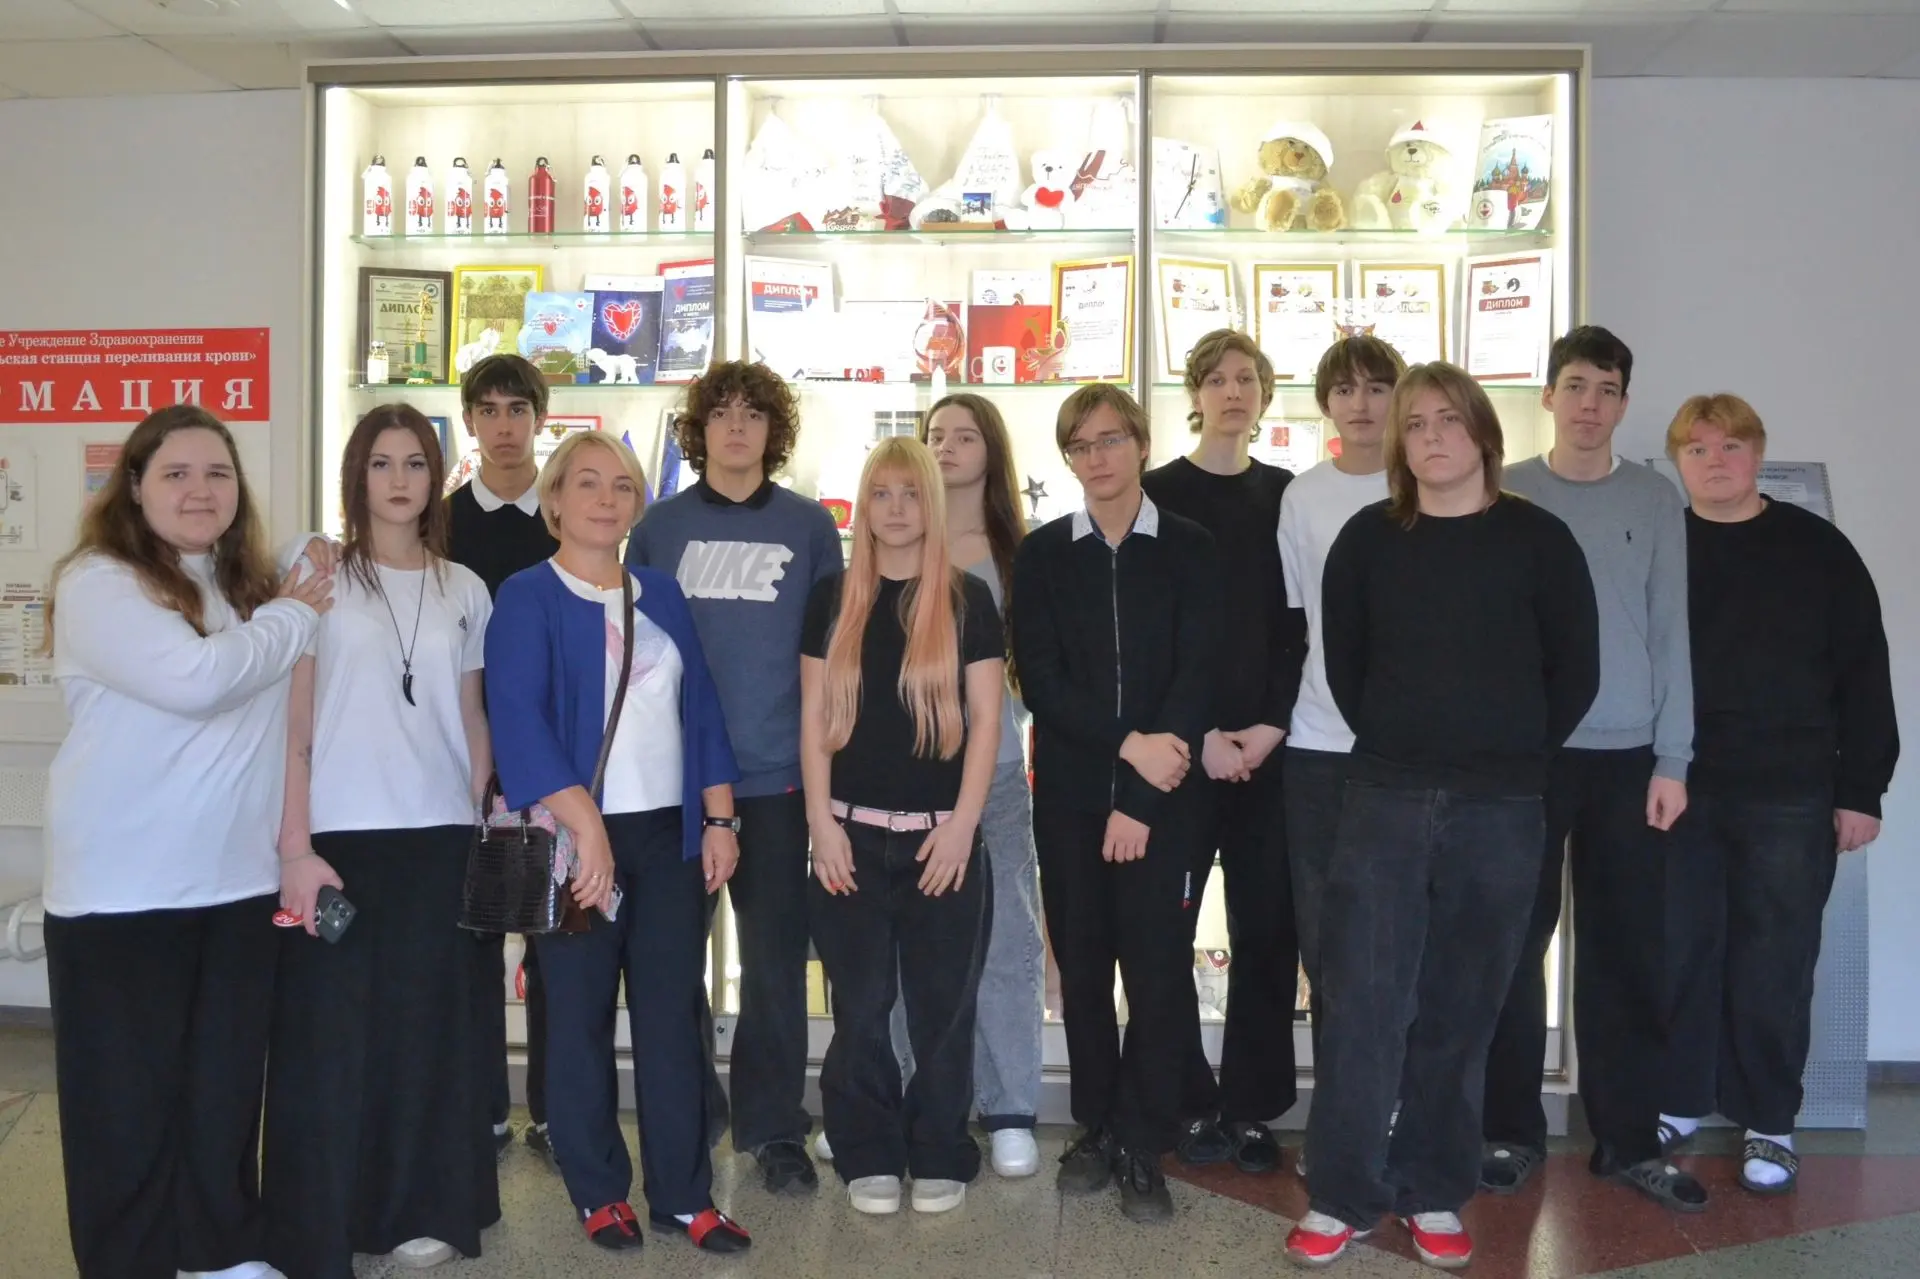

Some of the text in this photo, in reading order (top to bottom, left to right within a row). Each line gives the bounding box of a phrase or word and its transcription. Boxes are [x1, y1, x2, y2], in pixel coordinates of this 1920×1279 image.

[674, 302, 710, 313] ДИПЛОМ
[1485, 298, 1524, 309] ДИПЛОМ
[8, 333, 87, 350] Учреждение
[90, 332, 204, 349] Здравоохранения
[41, 353, 101, 366] станция
[104, 352, 201, 366] переливания
[204, 351, 257, 365] крови»
[0, 378, 254, 415] МАЦИЯ
[676, 540, 794, 602] NIKE
